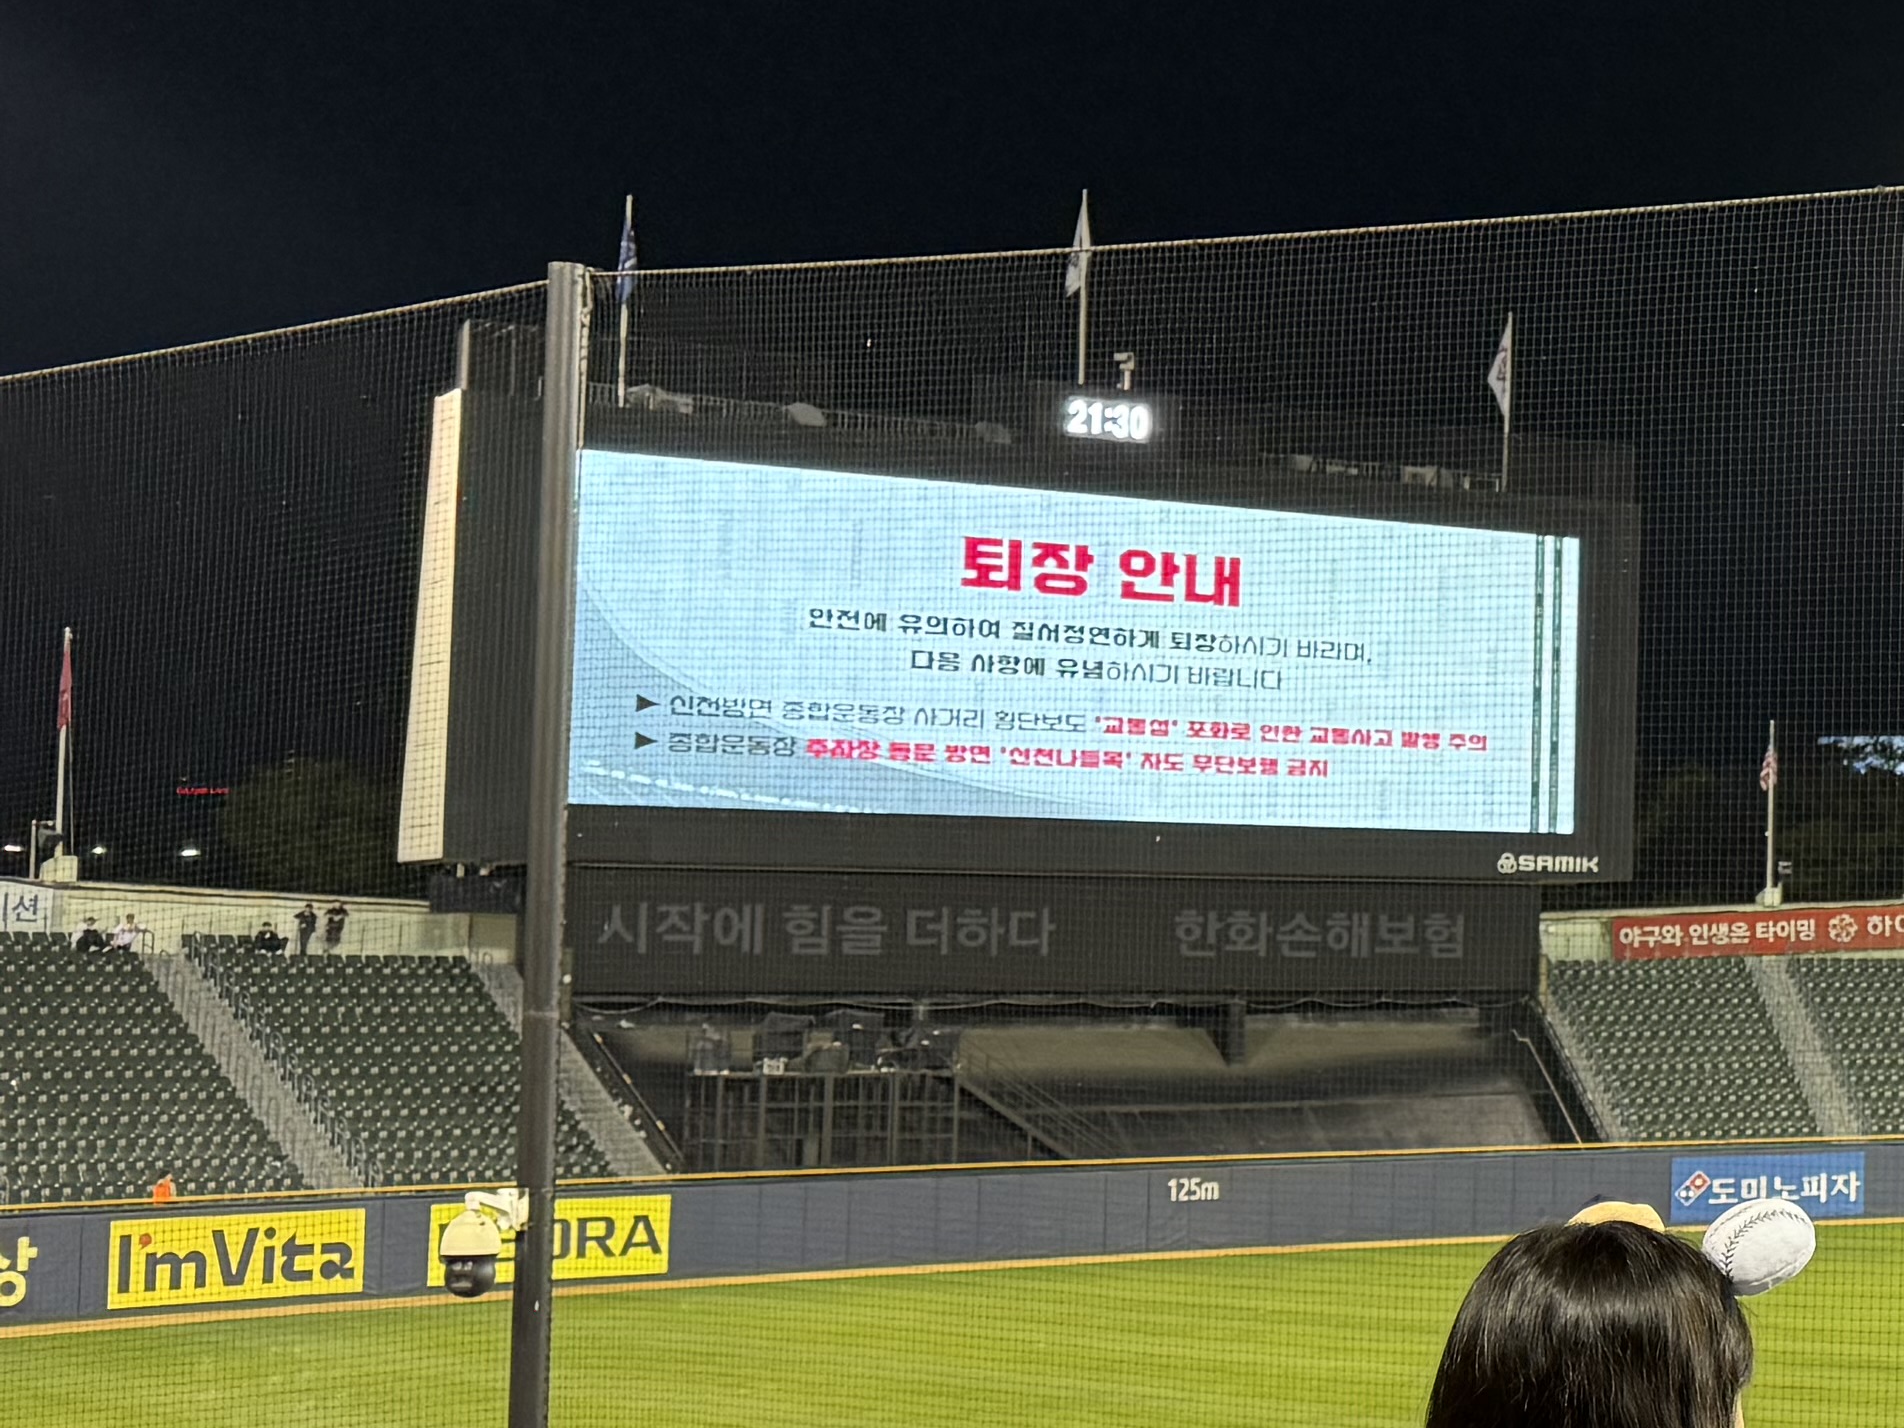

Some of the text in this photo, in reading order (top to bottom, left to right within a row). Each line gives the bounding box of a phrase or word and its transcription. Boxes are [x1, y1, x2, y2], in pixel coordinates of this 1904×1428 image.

[1066, 399, 1150, 442] 21:30
[960, 535, 1242, 607] 퇴장 안내
[809, 608, 1373, 665] 안전에 유의하여 질서정연하게 퇴장하시기 바라며,
[911, 650, 1283, 692] 다음 사항에 유념하시기 바랍니다
[782, 700, 905, 726] 종합운동장
[914, 706, 985, 732] 사거리
[995, 709, 1087, 734] 횡단보도
[1310, 725, 1394, 748] 교통사고
[1447, 733, 1489, 753] 주의
[668, 732, 797, 758] 종합운동장
[945, 744, 991, 766] 방면
[1517, 853, 1600, 874] SAMIK
[599, 901, 1057, 958] 시작에 힘을 더하다
[1174, 909, 1465, 960] 한화손해보험
[1619, 925, 1683, 947] 야구와
[1689, 922, 1751, 946] 인생은
[1755, 919, 1816, 943] 타이밍
[1167, 1178, 1220, 1203] 125m
[1709, 1171, 1861, 1204] 도미노피자
